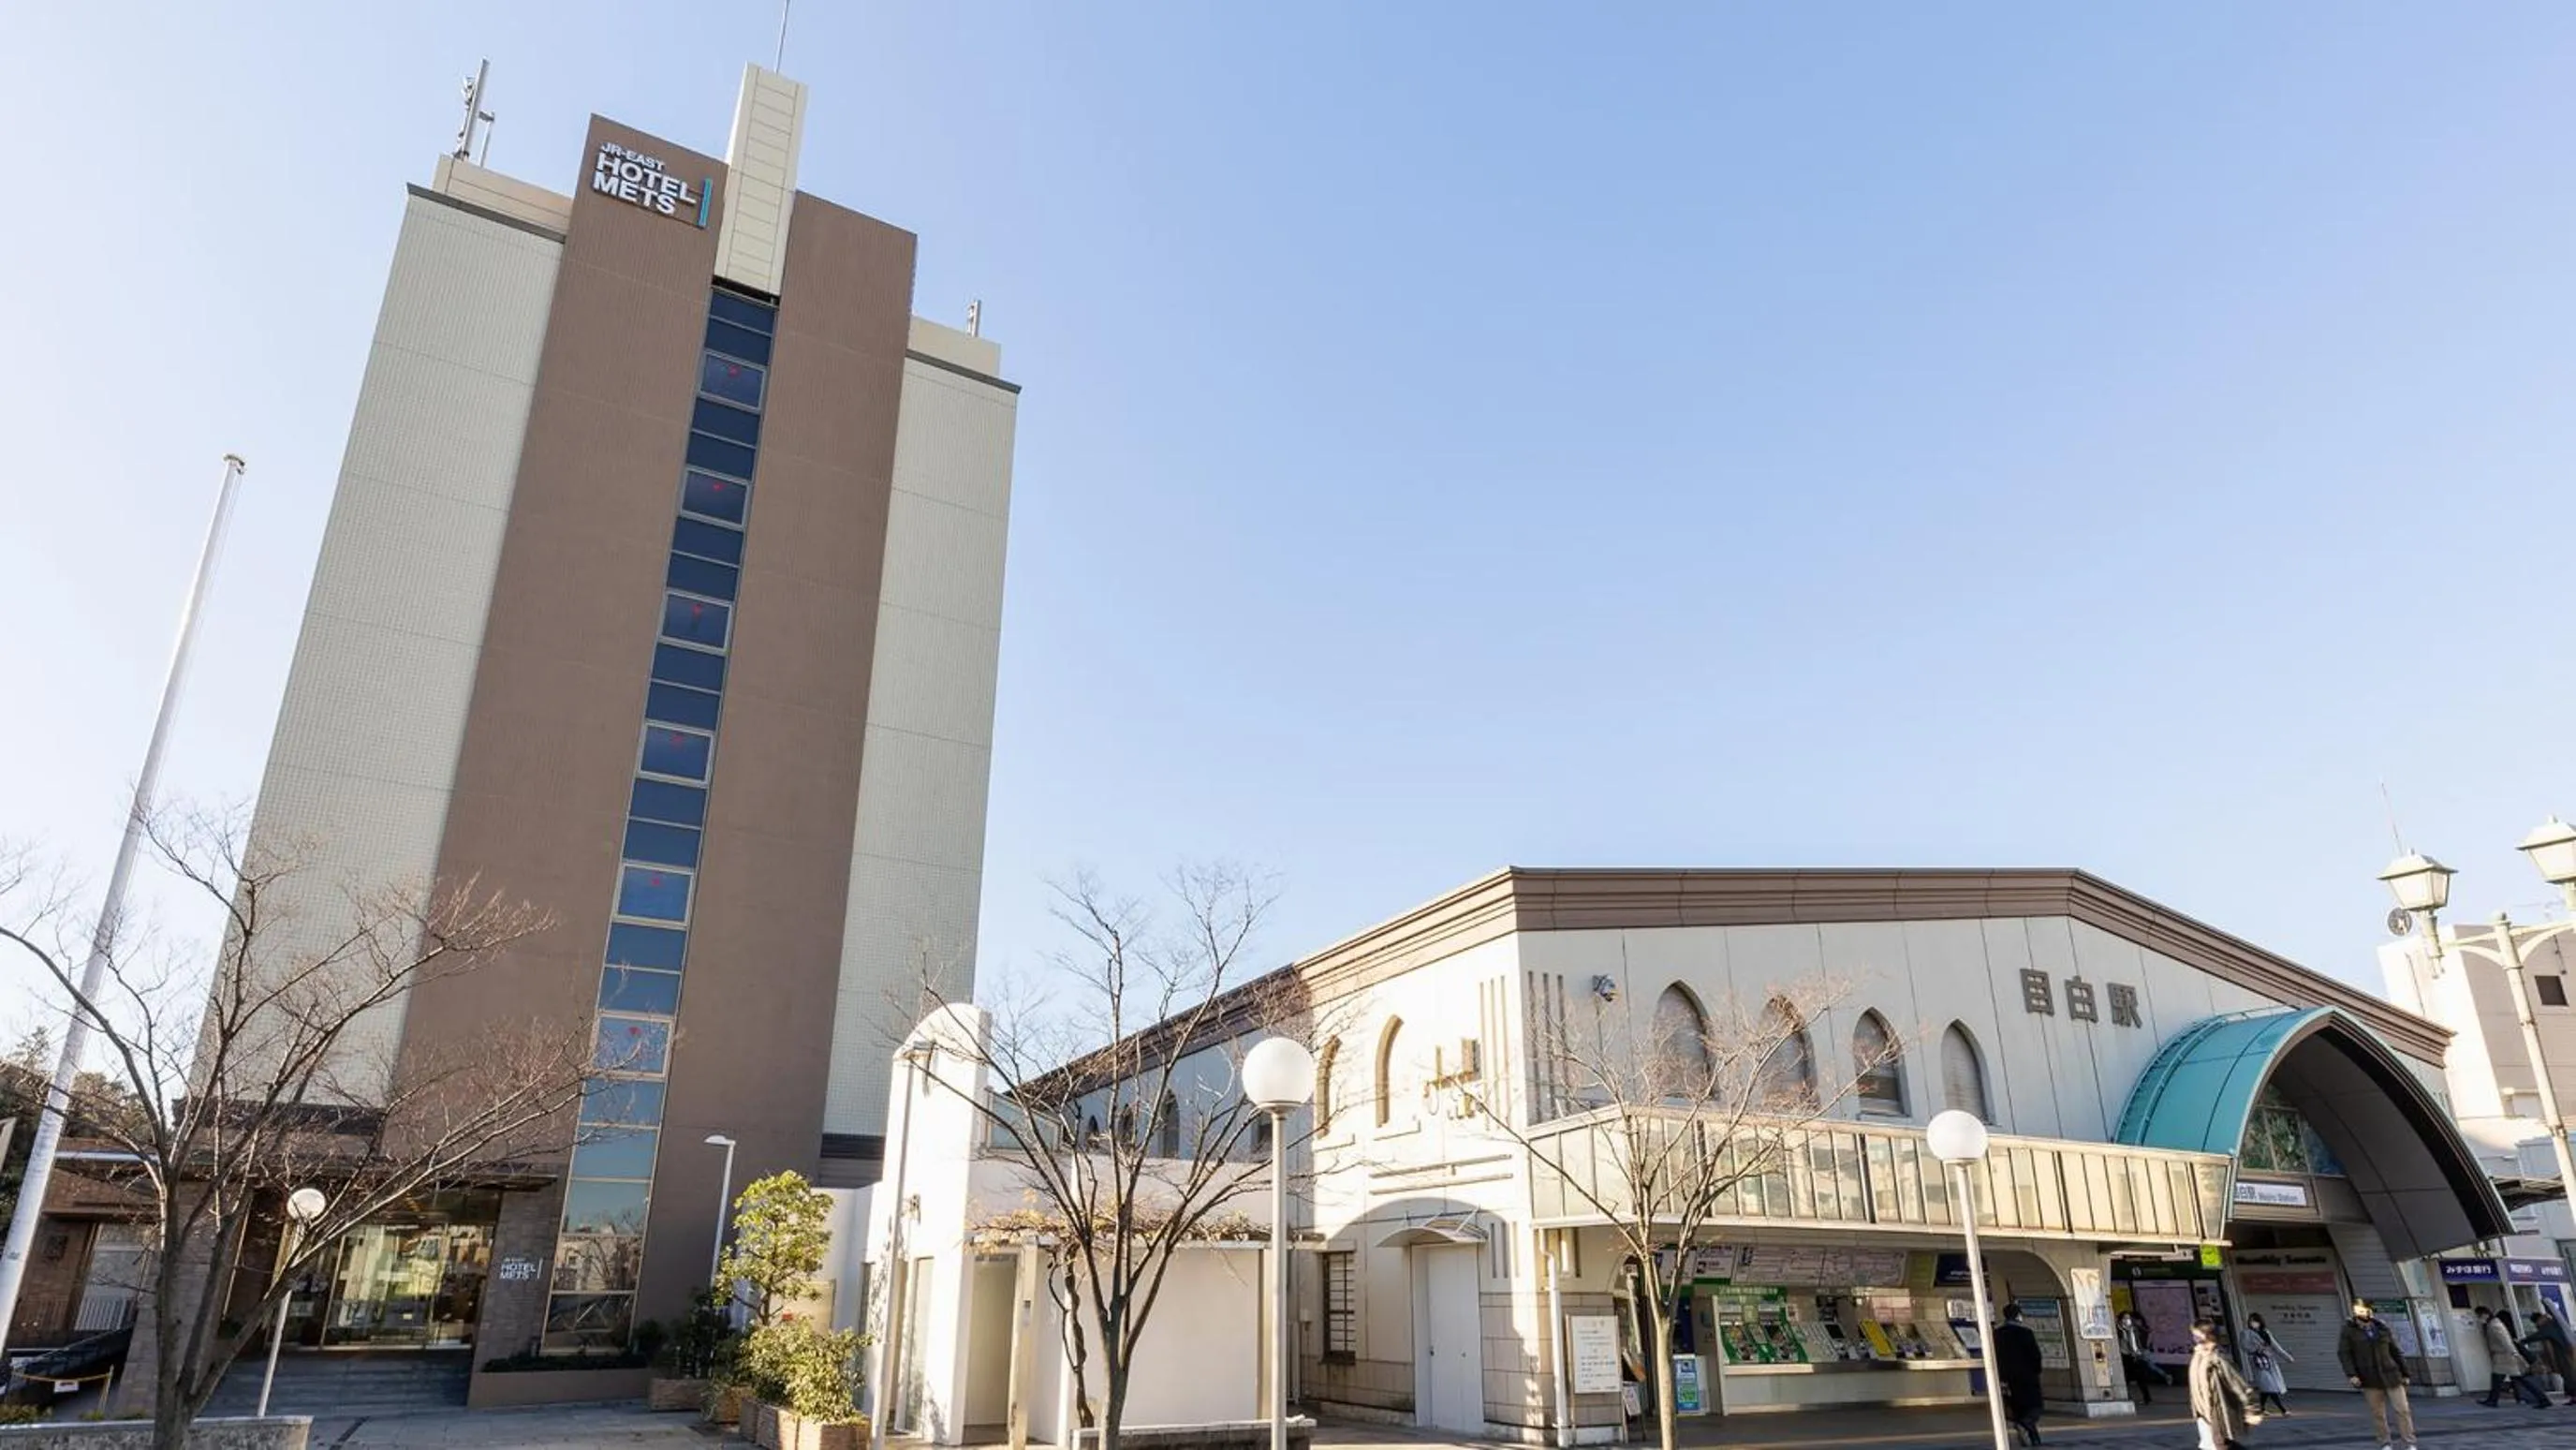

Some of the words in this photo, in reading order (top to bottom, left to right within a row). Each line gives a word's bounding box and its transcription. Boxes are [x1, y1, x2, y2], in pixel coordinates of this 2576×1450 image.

[600, 141, 666, 170] JR-EAST
[593, 170, 676, 215] METS
[596, 152, 697, 204] HOTEL
[2019, 968, 2143, 1029] 目白駅
[499, 1270, 530, 1280] METS
[501, 1263, 536, 1272] HOTEL
